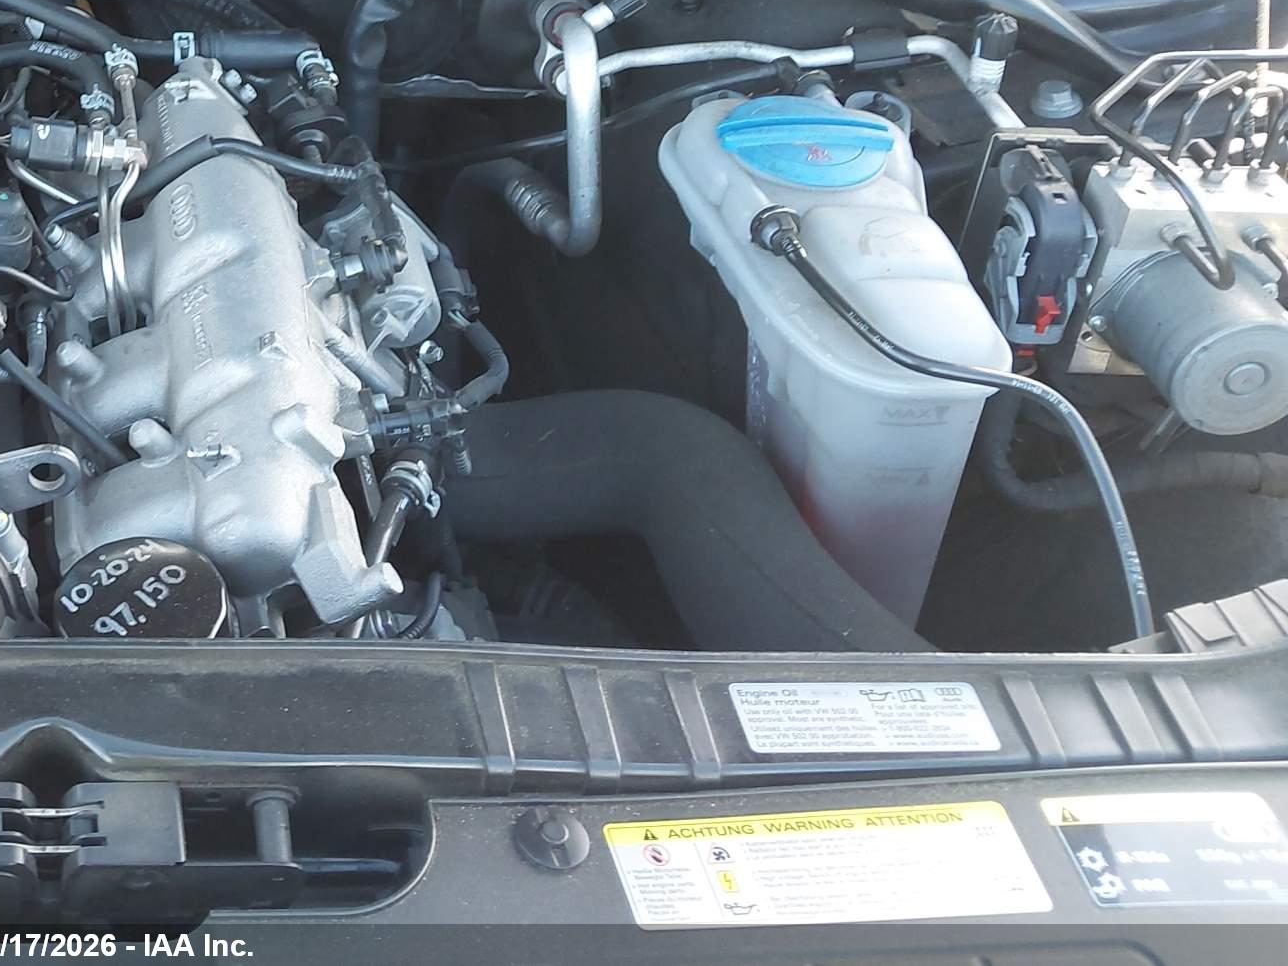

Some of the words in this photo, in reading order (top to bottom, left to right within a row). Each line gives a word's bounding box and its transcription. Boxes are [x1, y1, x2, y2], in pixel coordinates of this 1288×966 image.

[880, 406, 933, 420] MAX
[737, 689, 778, 699] Engine
[781, 688, 799, 697] Oil
[740, 698, 772, 706] Huile
[775, 698, 821, 707] moteur
[667, 823, 755, 840] ACHTUNG
[763, 817, 855, 834] WARNING
[865, 811, 964, 827] ATTENTION
